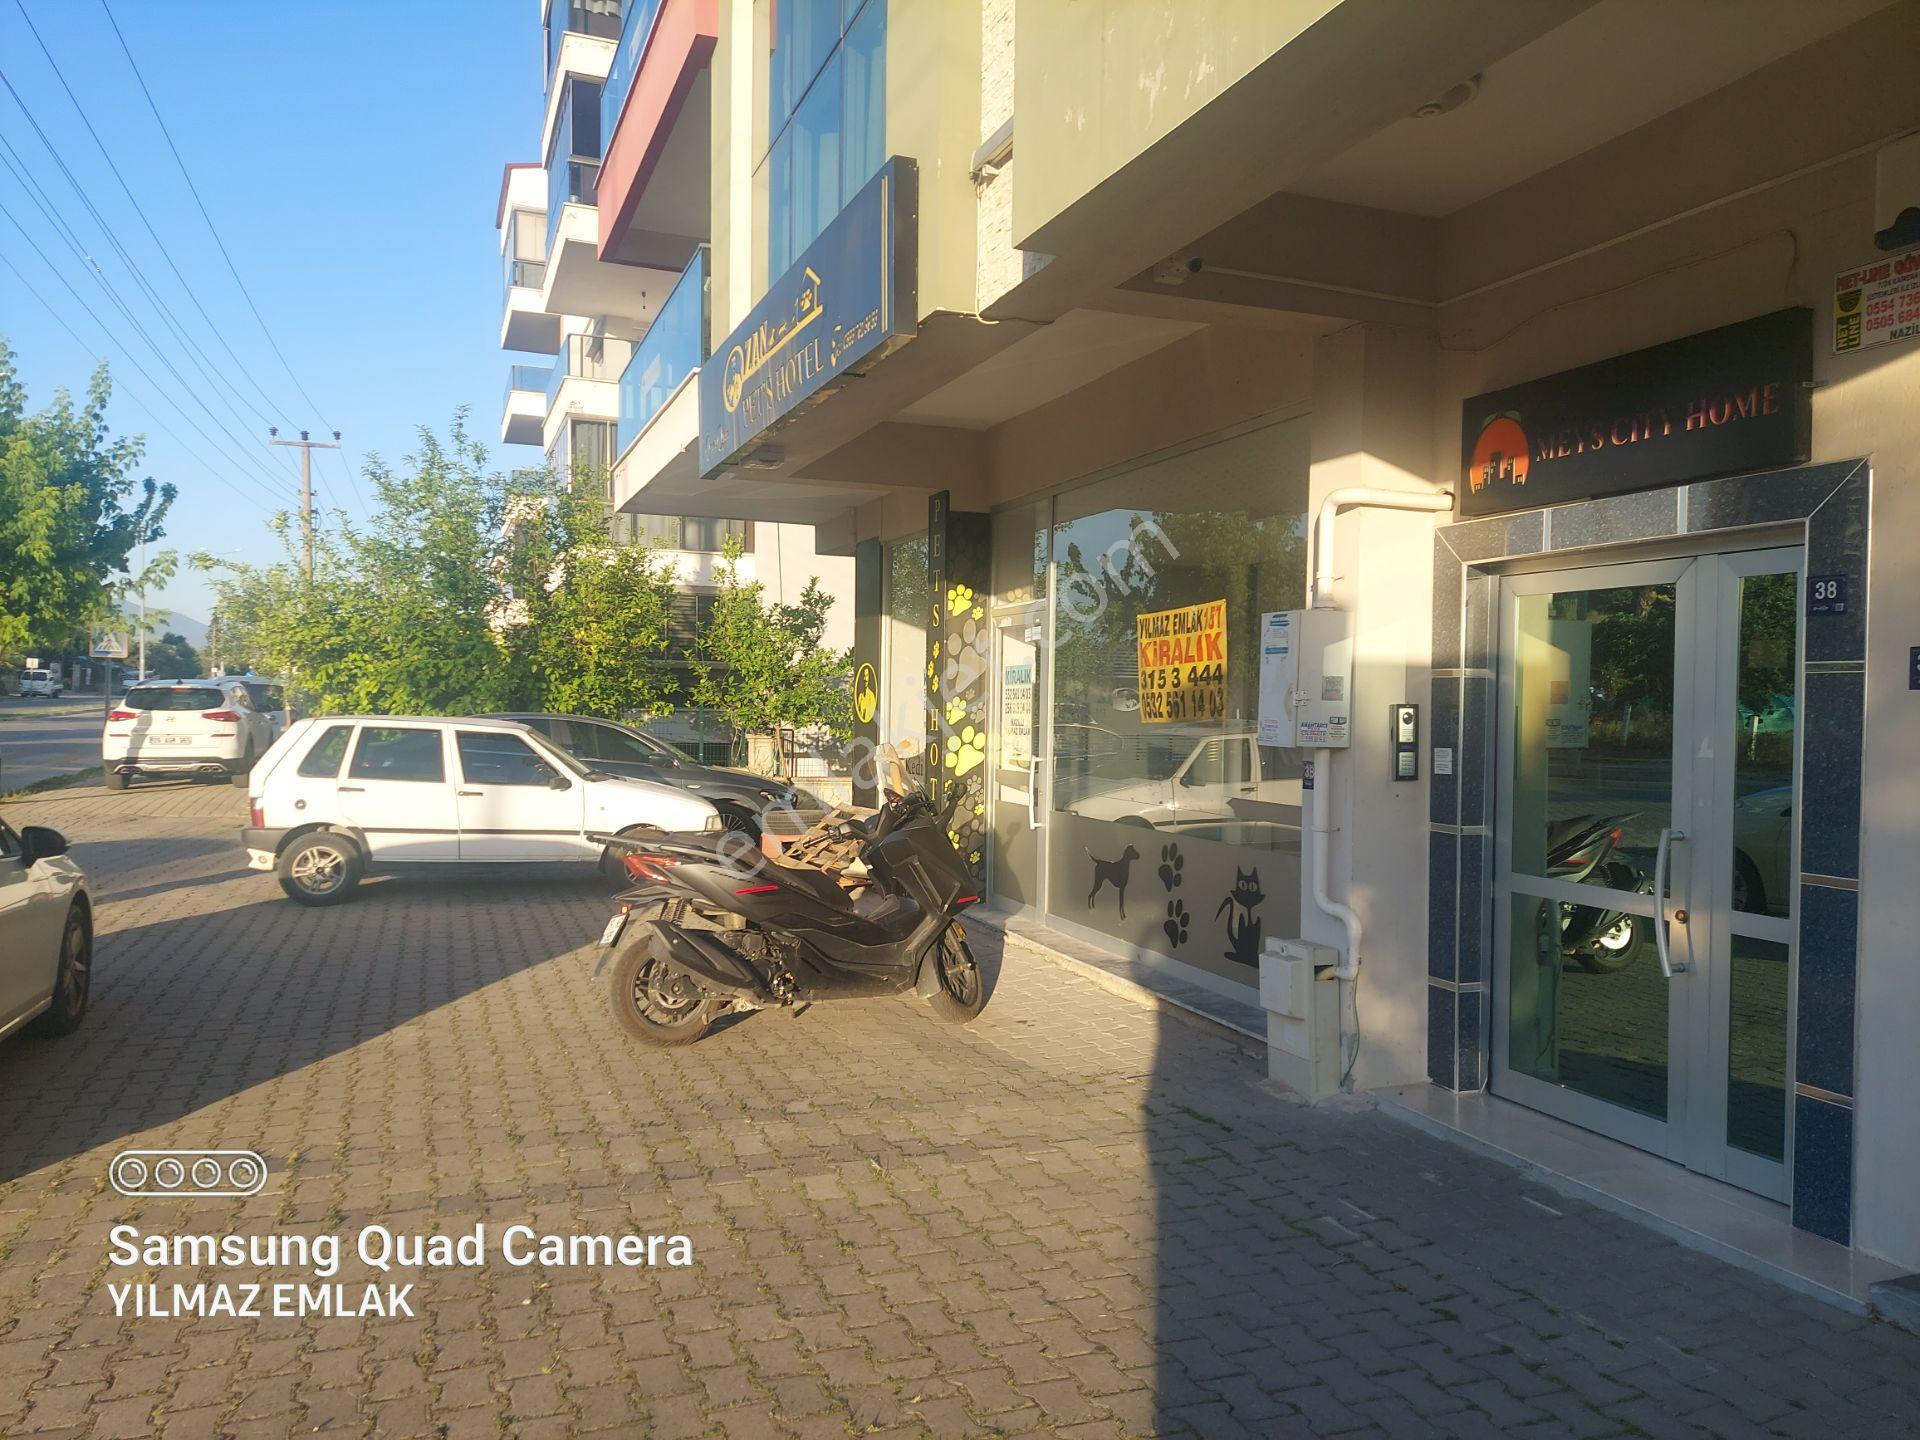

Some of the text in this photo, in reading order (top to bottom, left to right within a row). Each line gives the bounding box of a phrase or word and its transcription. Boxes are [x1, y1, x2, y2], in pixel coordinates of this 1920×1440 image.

[1866, 299, 1895, 317] 0554
[1866, 314, 1895, 332] 0505
[776, 338, 824, 401] HOTEL
[1611, 408, 1673, 446] CITY
[1686, 382, 1780, 431] HOME
[1815, 581, 1837, 600] 38
[1140, 614, 1169, 639] YILMAZ
[1173, 610, 1203, 635] EMLAK
[1140, 631, 1223, 668] KİRALIK
[1142, 691, 1163, 719] 0532
